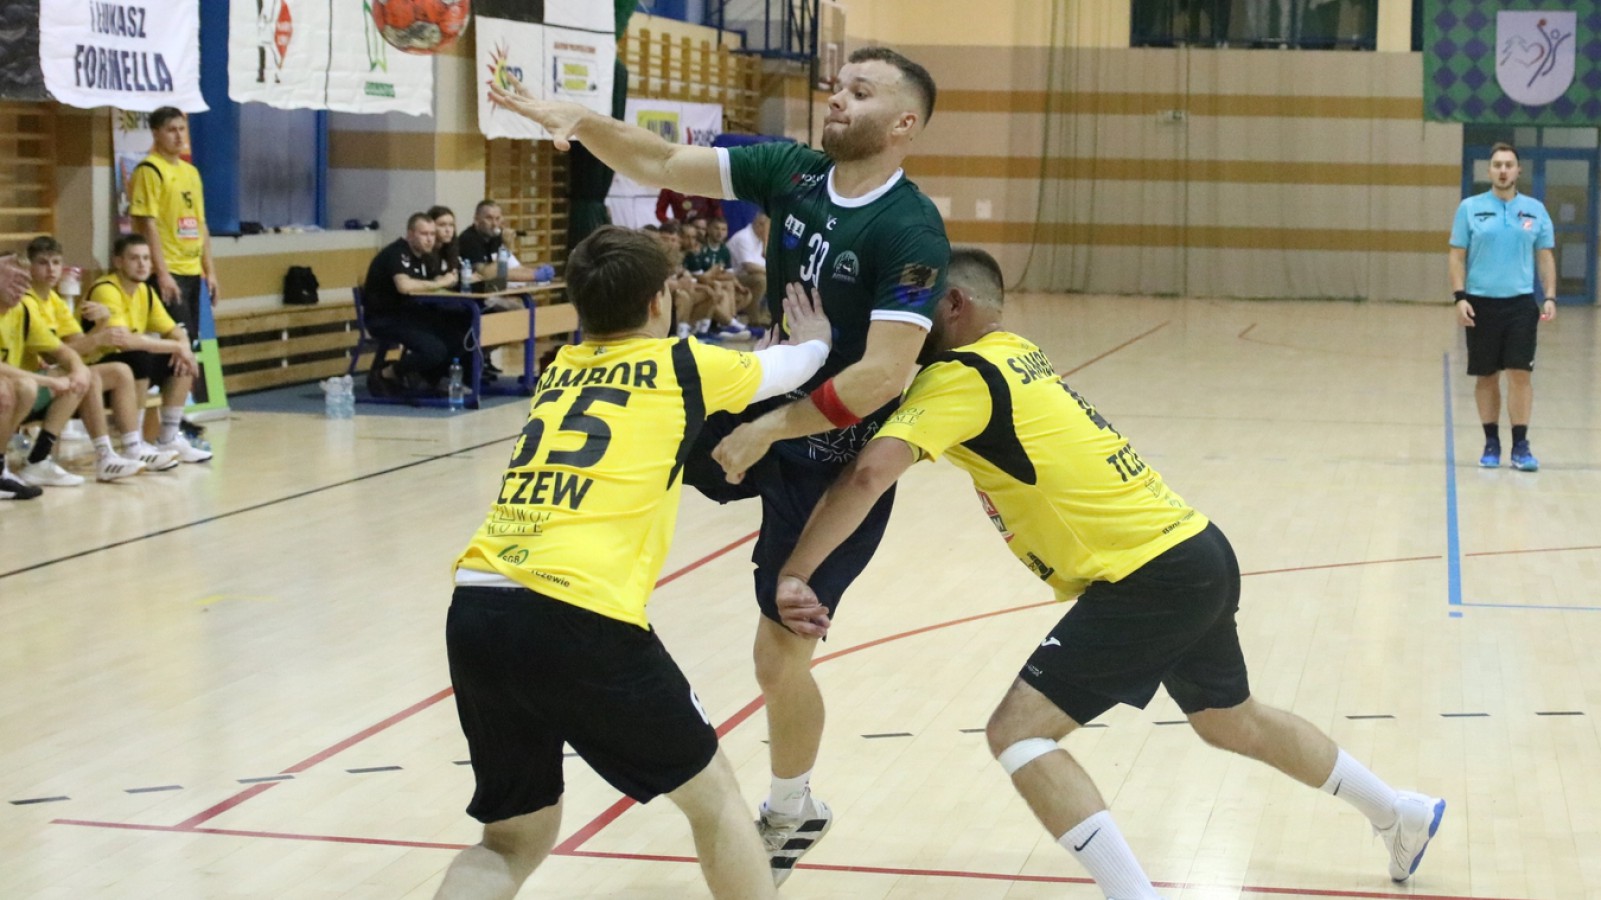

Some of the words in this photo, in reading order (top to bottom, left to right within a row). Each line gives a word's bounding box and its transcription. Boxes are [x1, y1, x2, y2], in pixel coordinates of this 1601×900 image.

[535, 359, 658, 394] AMBOR
[507, 386, 632, 470] 65
[497, 471, 595, 511] CZEW
